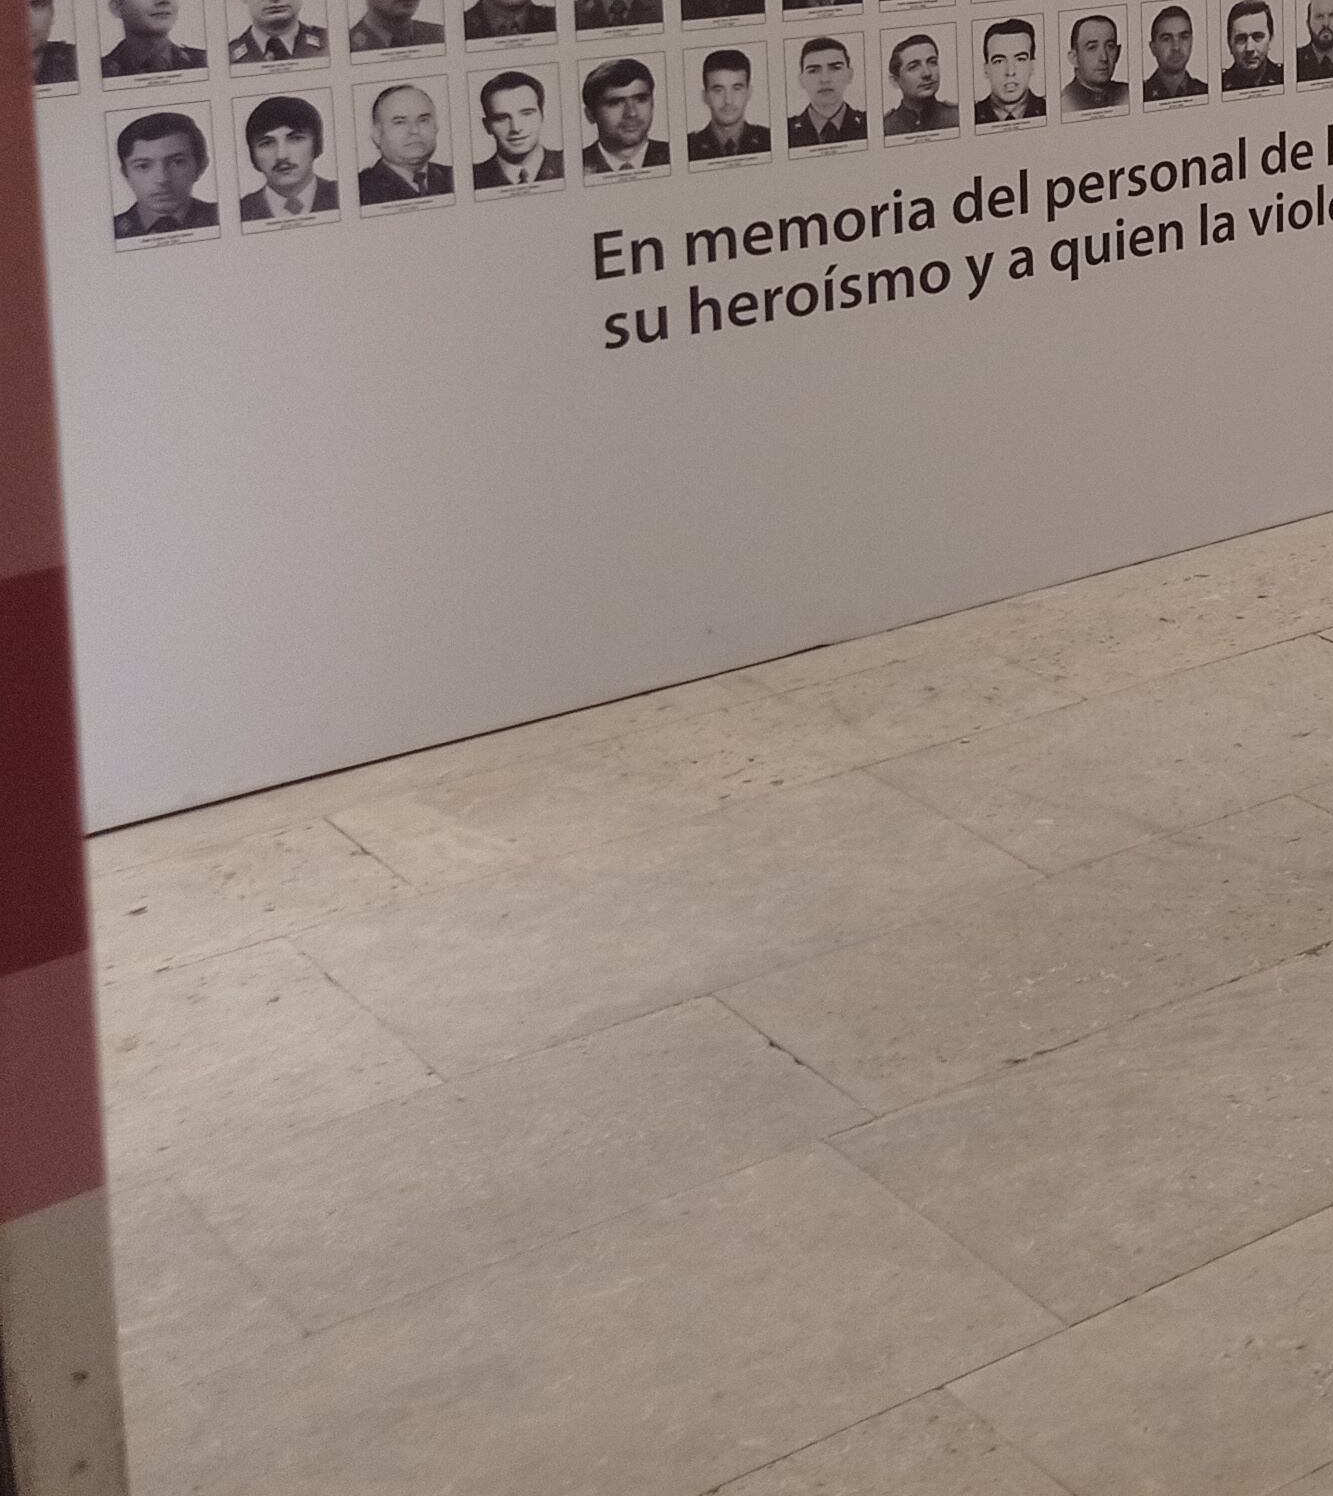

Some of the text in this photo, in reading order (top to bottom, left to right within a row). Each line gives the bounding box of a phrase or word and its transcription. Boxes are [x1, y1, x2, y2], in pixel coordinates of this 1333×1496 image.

[593, 228, 664, 281] En
[684, 187, 936, 267] memoria
[952, 167, 1029, 225] del
[1045, 135, 1247, 223] personal
[1260, 130, 1314, 176] de
[604, 304, 669, 350] su
[688, 259, 951, 335] heroísmo
[964, 251, 995, 301] y
[1008, 245, 1035, 280] a
[1049, 217, 1184, 282] quien
[1199, 201, 1235, 247] la
